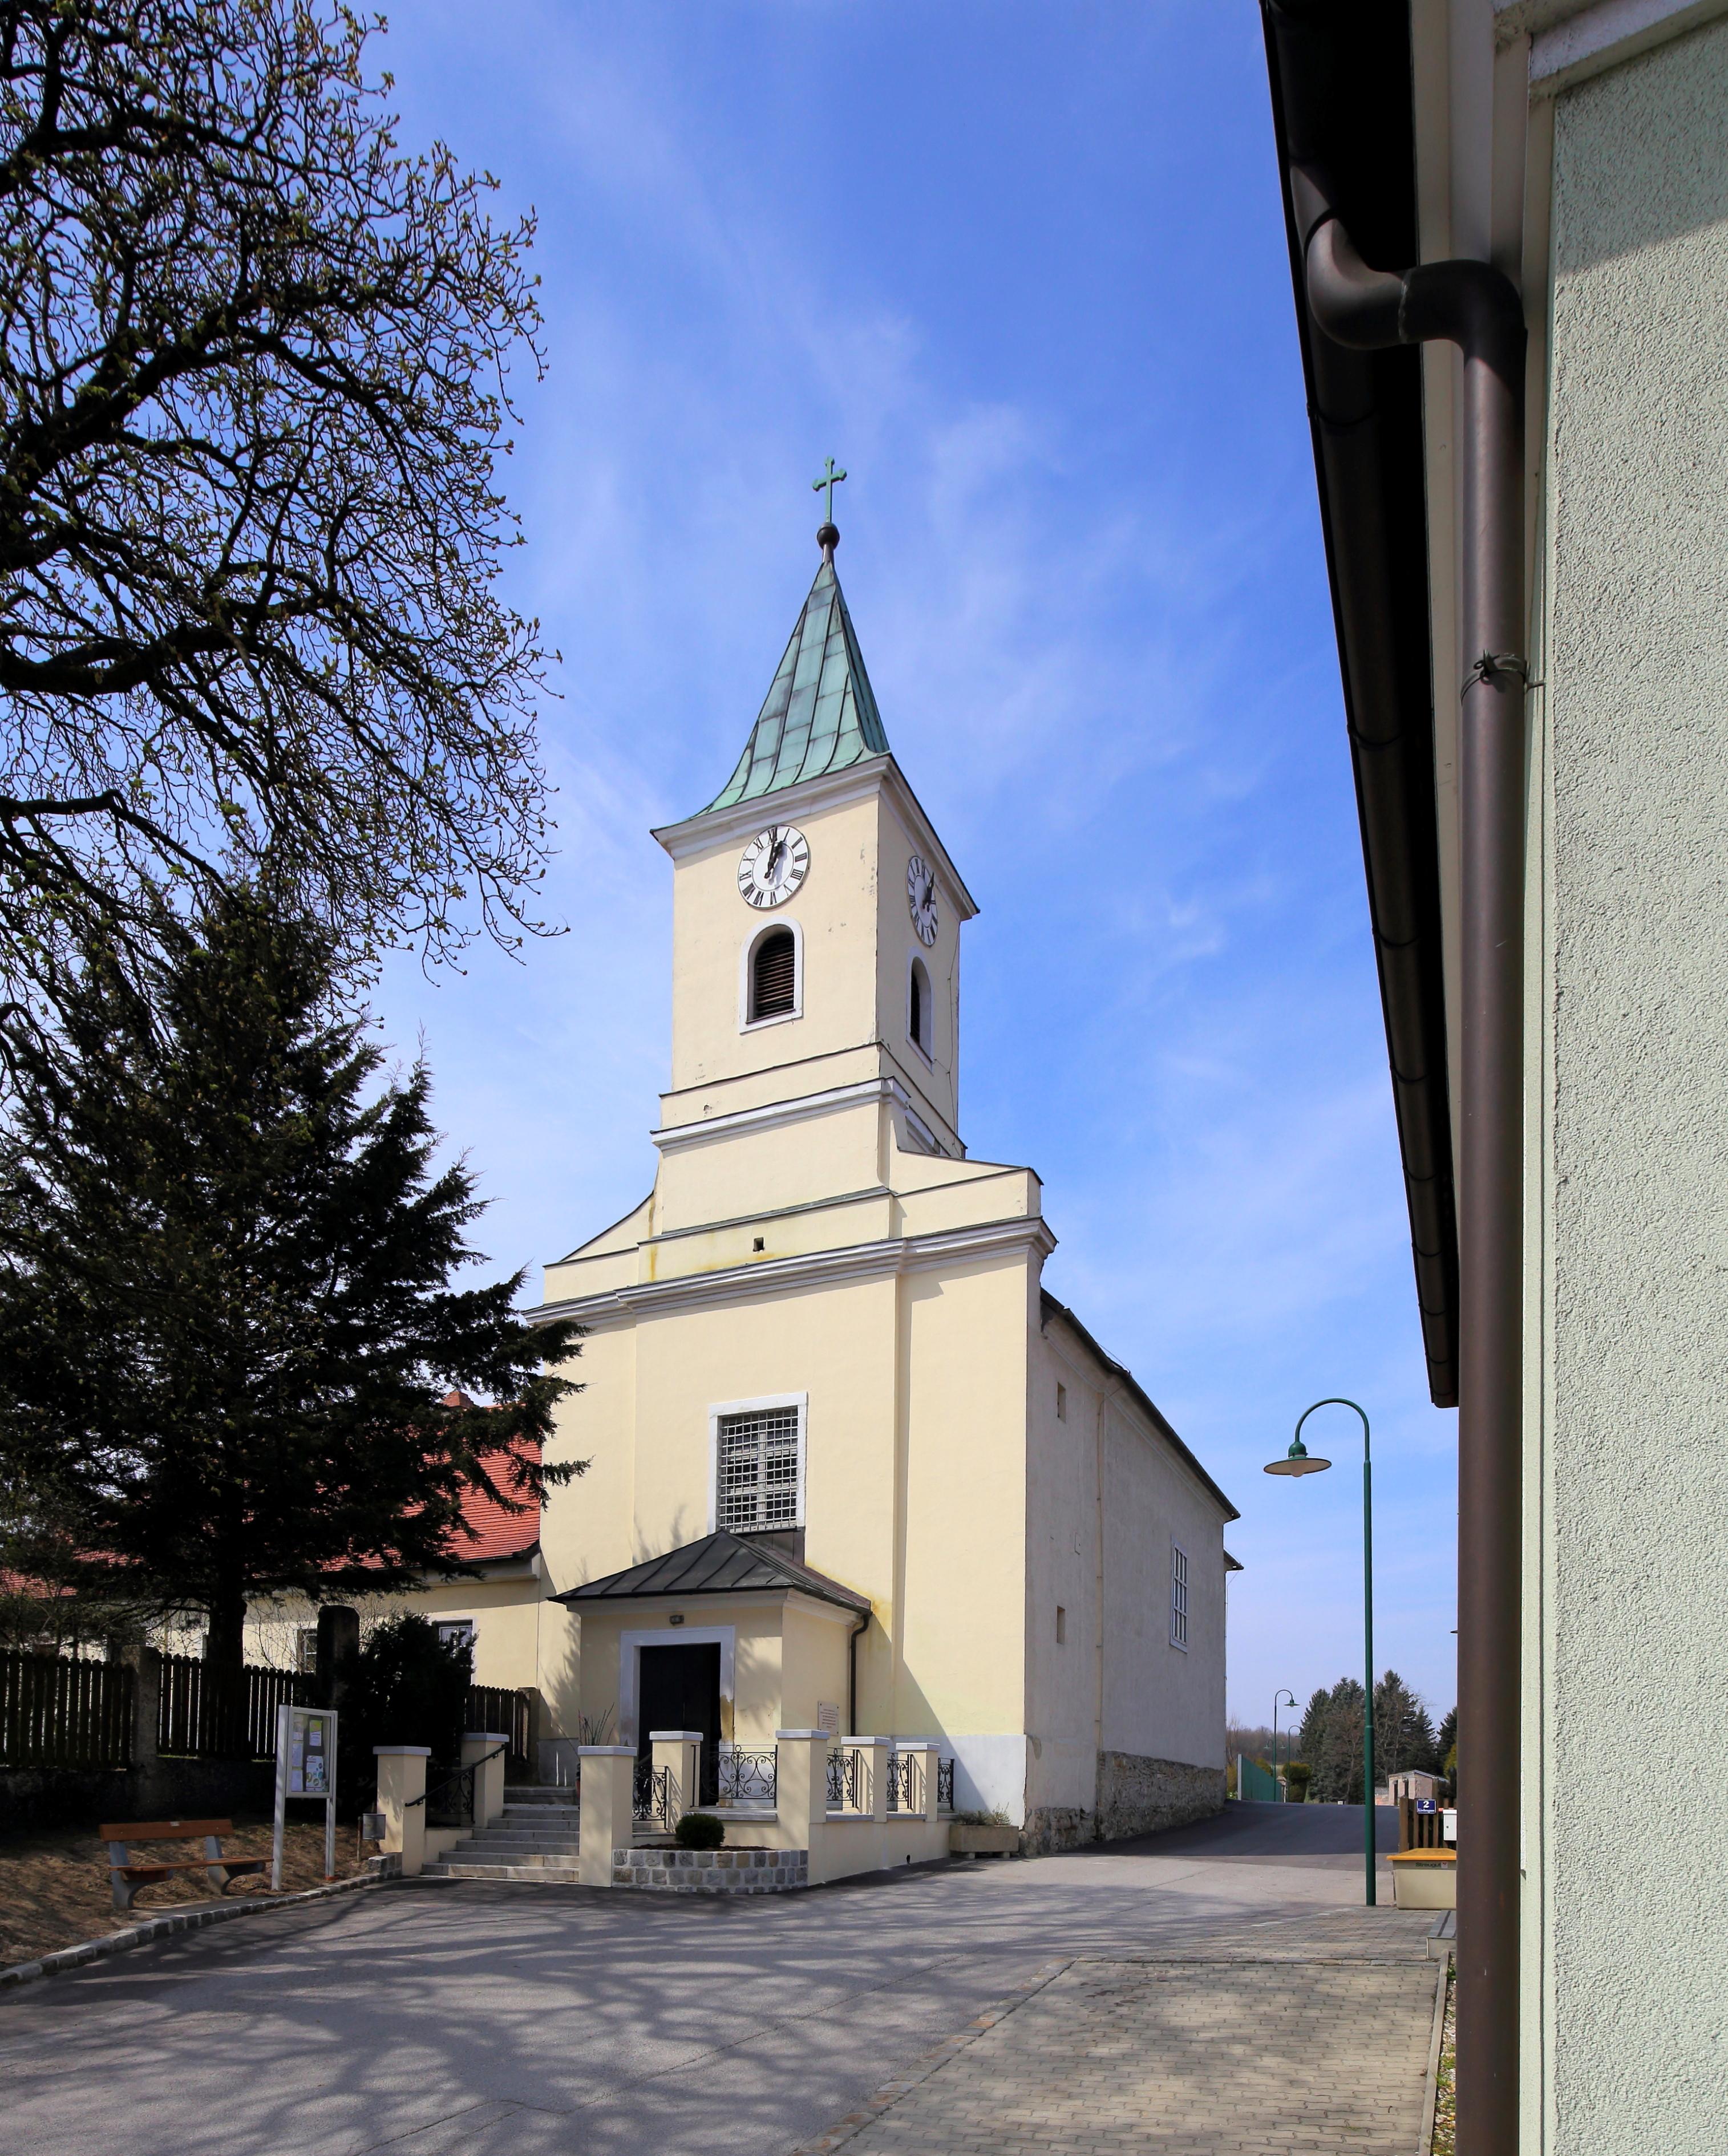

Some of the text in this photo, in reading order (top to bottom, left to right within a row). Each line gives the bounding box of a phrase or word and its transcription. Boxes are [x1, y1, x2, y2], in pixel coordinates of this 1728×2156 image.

[783, 828, 790, 842] I
[753, 836, 764, 853] XI
[791, 836, 803, 849] II
[743, 853, 755, 864] X
[795, 852, 807, 862] III
[739, 870, 751, 881] IX
[790, 869, 804, 881] IIII
[783, 884, 792, 896] V
[770, 891, 777, 905] VI
